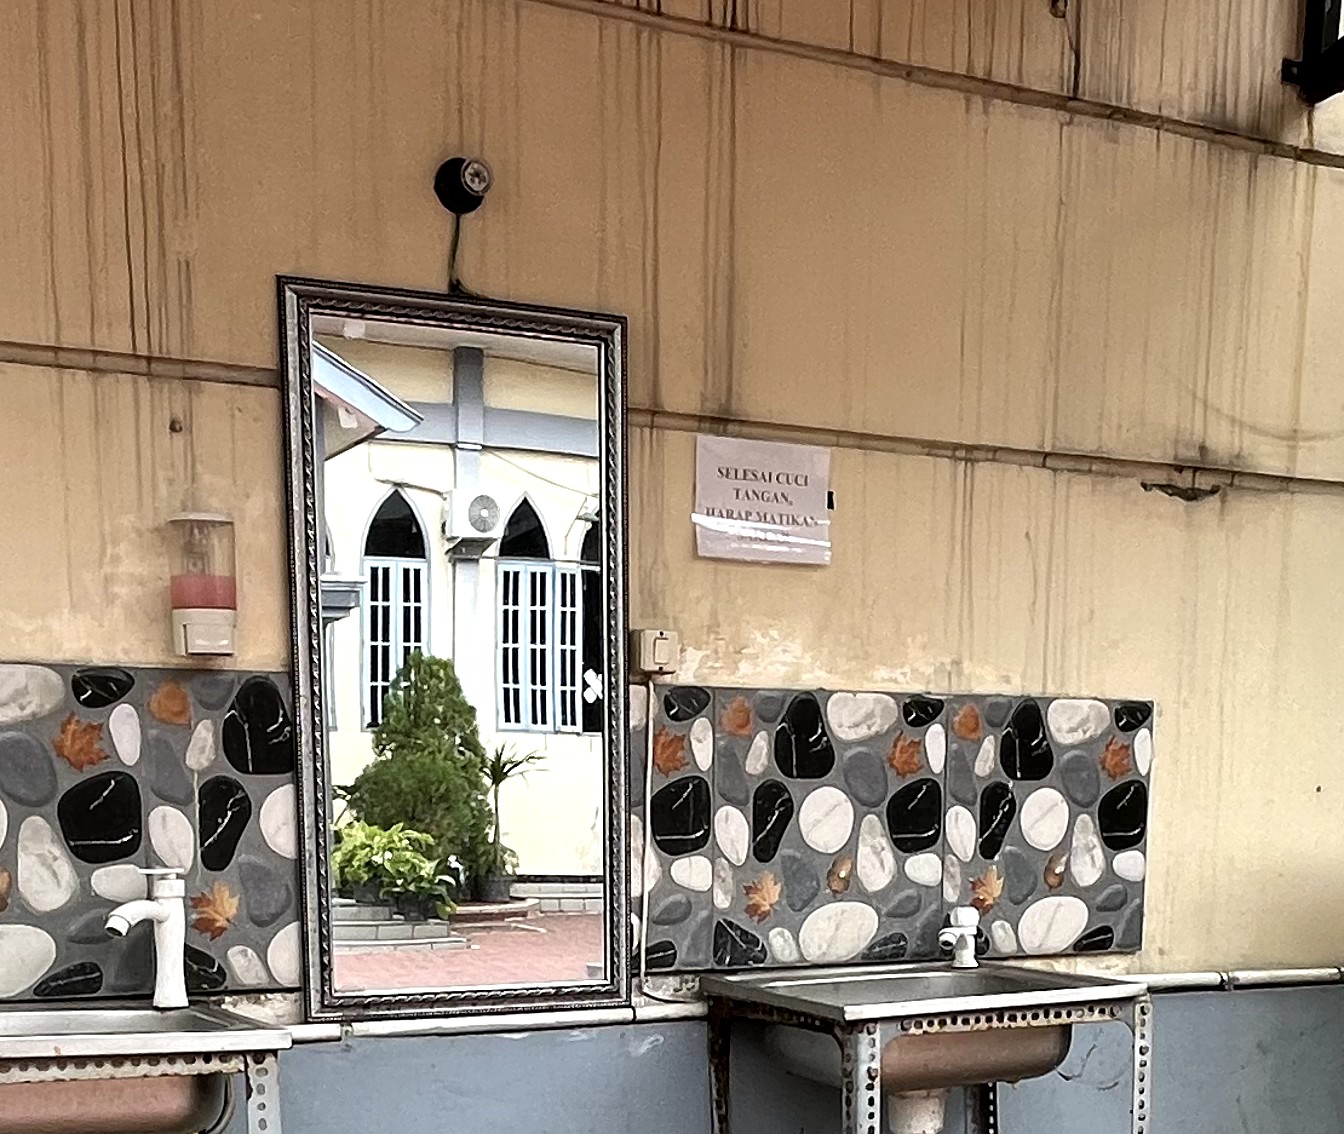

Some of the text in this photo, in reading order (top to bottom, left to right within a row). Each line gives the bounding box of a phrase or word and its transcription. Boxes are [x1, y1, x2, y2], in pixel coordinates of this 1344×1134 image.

[717, 466, 809, 487] SELESAI CUCI
[733, 488, 793, 506] TANGAN,
[705, 507, 753, 522] HARAP
